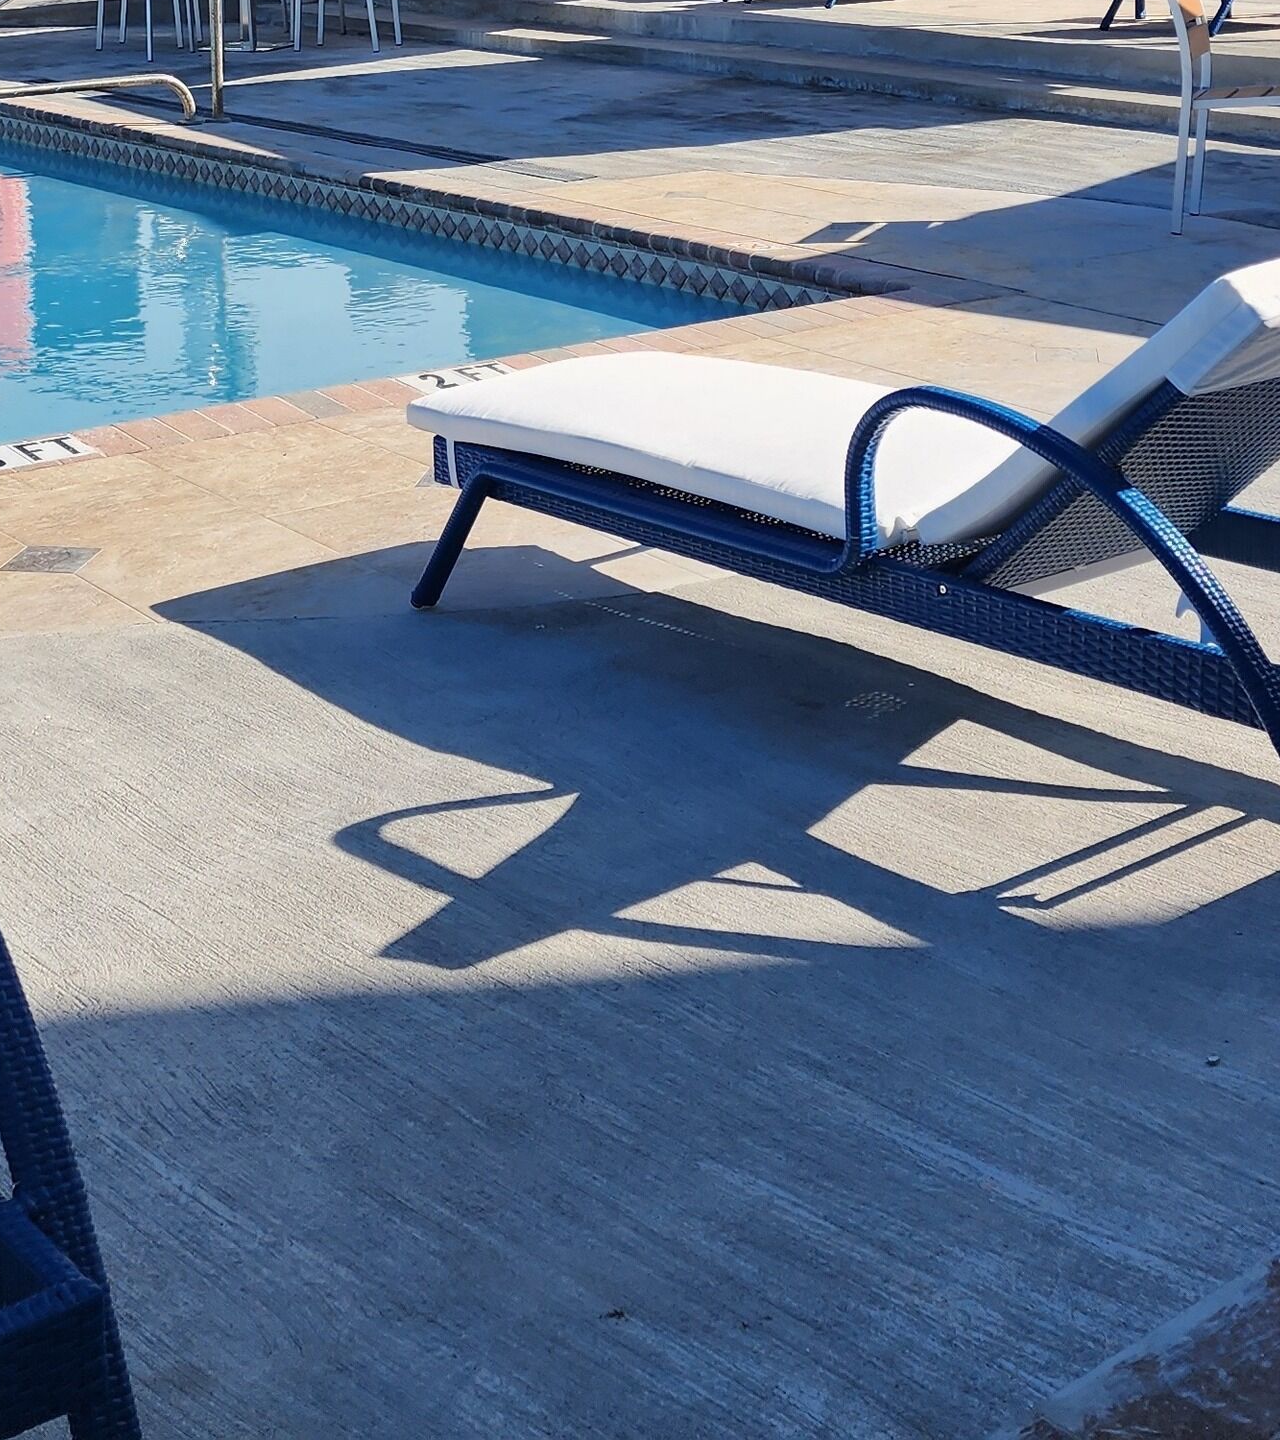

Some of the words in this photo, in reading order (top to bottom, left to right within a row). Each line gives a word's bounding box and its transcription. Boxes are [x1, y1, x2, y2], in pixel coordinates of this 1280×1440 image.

[418, 373, 459, 389] 2
[453, 362, 509, 381] FT
[13, 436, 81, 461] FT
